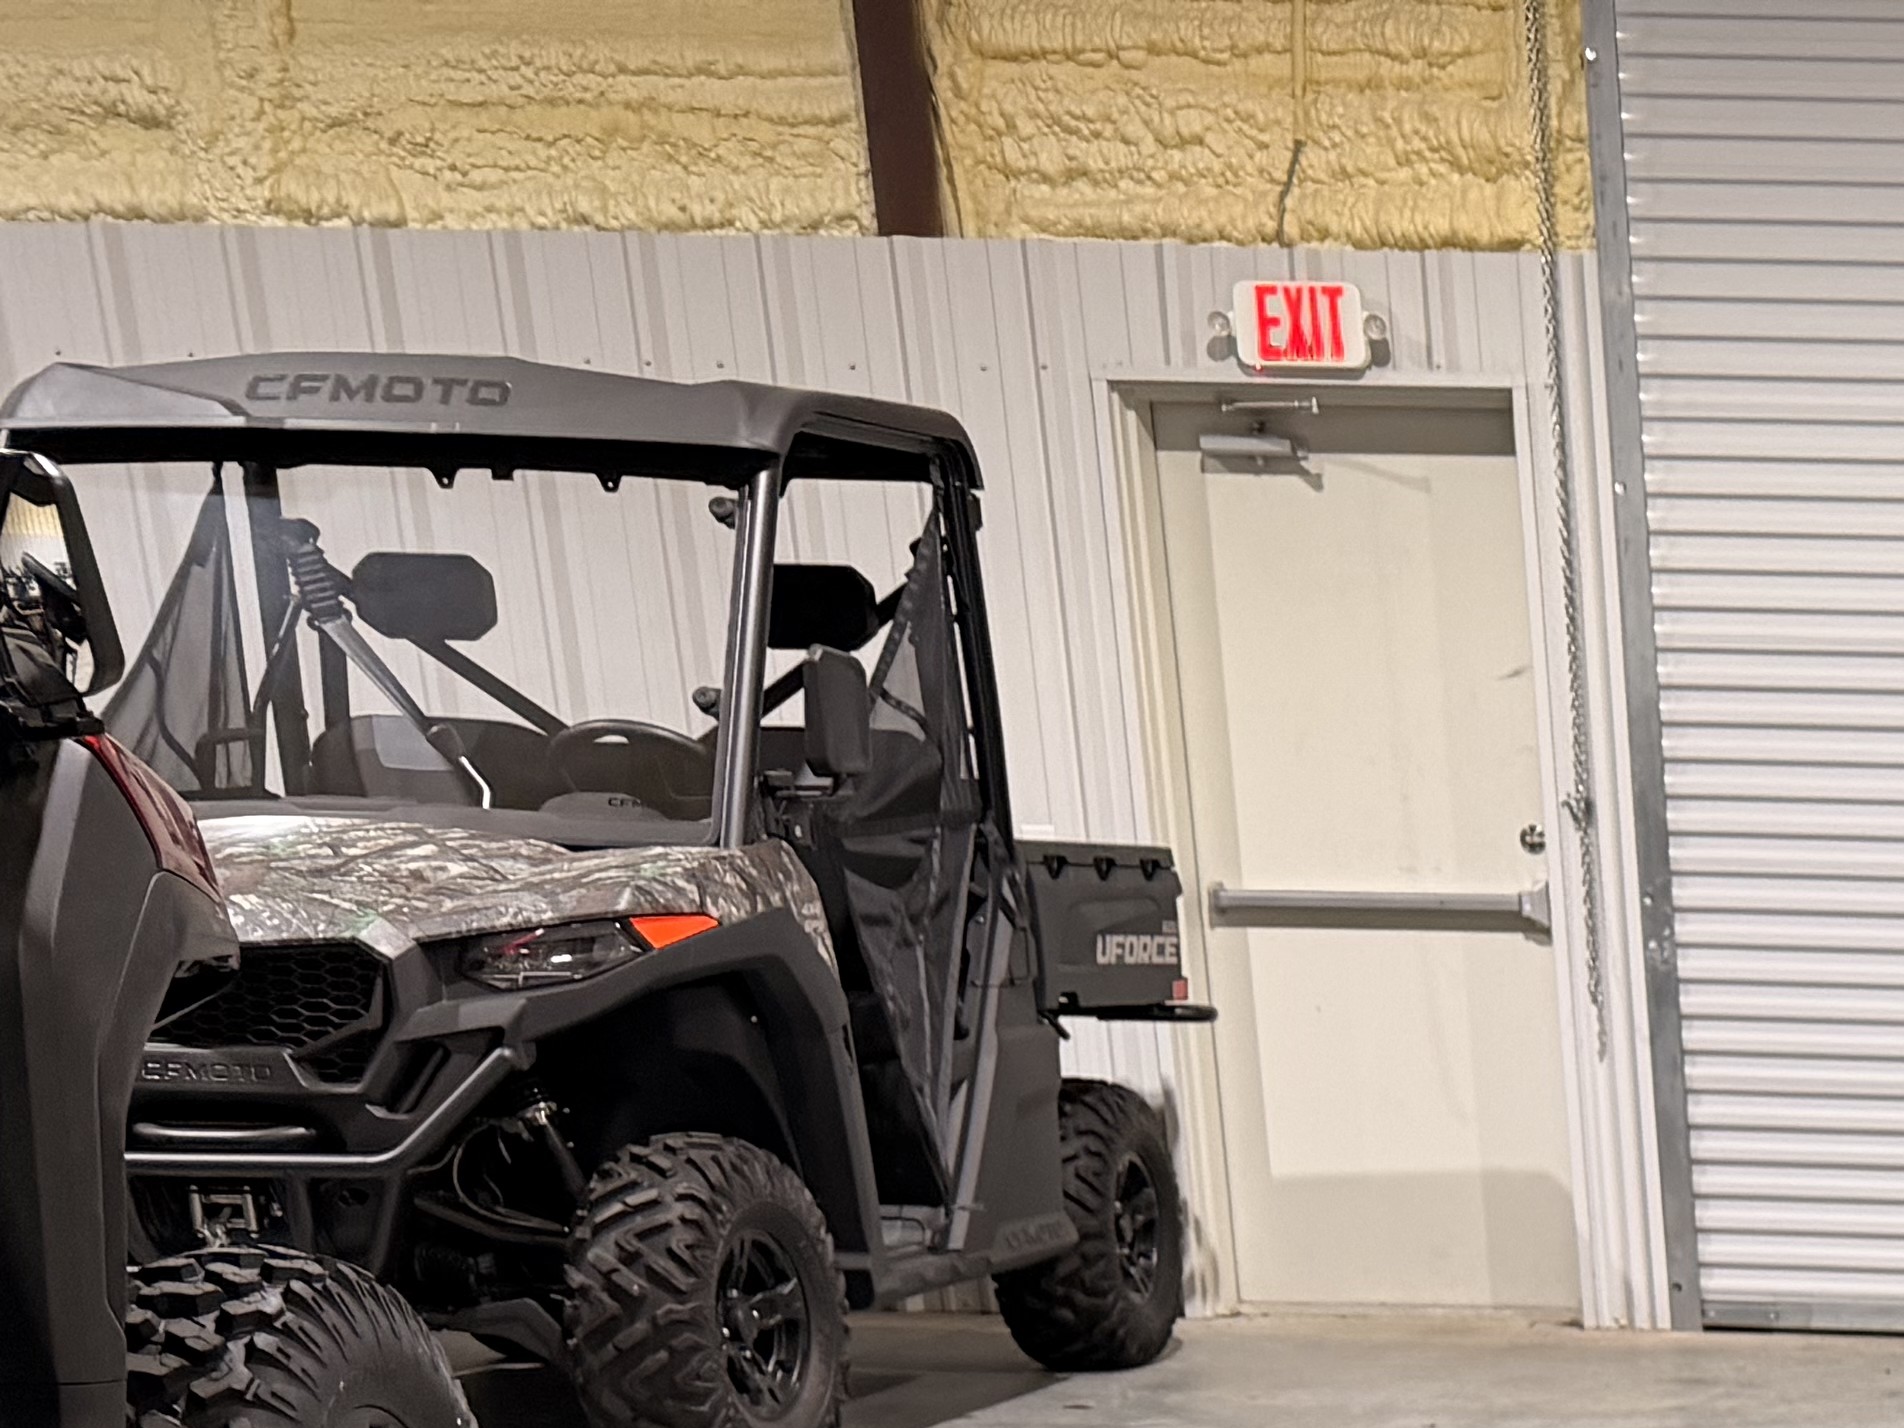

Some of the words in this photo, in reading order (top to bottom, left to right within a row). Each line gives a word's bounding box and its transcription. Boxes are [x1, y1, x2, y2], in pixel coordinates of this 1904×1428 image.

[1255, 285, 1345, 362] EXIT
[245, 373, 511, 406] CFMOTO
[1096, 934, 1179, 965] UFORCE
